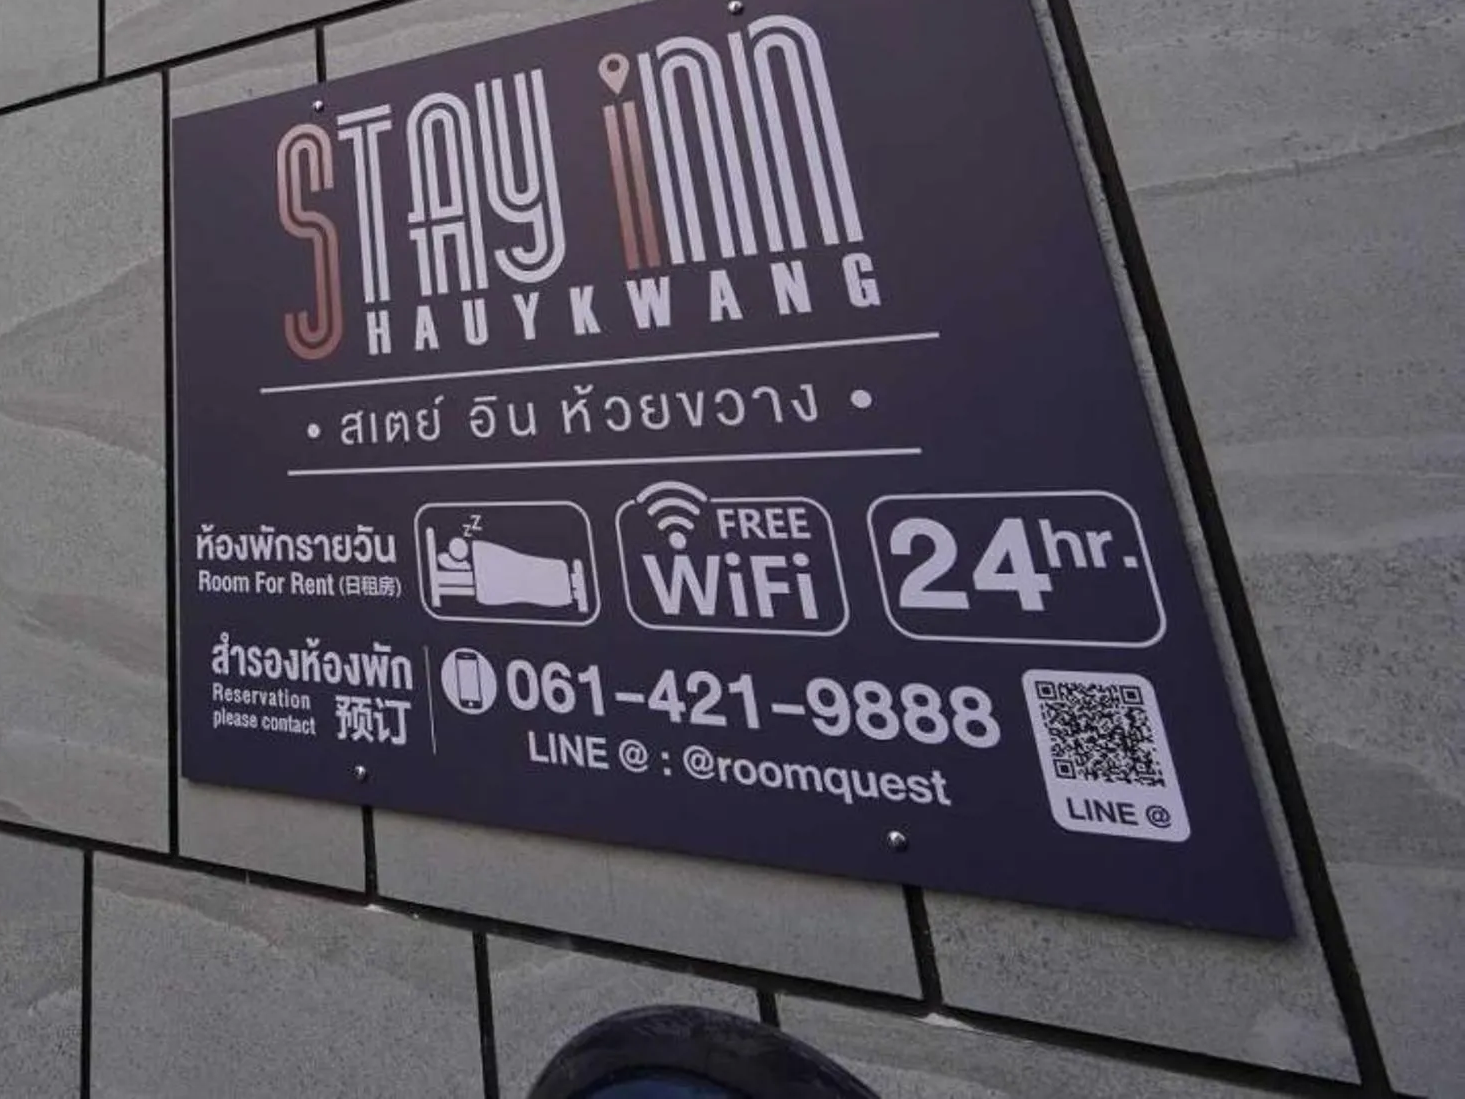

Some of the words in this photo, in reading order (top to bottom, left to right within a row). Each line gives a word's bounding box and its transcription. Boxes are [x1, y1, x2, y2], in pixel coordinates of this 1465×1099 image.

[276, 68, 566, 360] STAY
[366, 252, 881, 356] HAUYKWANG
[339, 394, 444, 446] สเตย์
[469, 394, 538, 438] อิน
[561, 383, 819, 435] ห้วยขวาง
[195, 523, 397, 564] ห้องพักรายวัน
[716, 508, 812, 540] FREE
[197, 569, 250, 593] Room
[255, 571, 286, 595] For
[290, 571, 335, 596] Rent
[642, 551, 820, 619] WiFi
[211, 631, 414, 690] สำรองห้องพัก
[212, 682, 311, 710] Reservation
[213, 707, 258, 729] please
[261, 714, 316, 735] contact
[335, 694, 412, 745] 预订
[506, 659, 1001, 749] 061-421-9888
[528, 731, 609, 770] LINE
[684, 744, 951, 806] @roomquest
[1066, 797, 1139, 826] LINE
